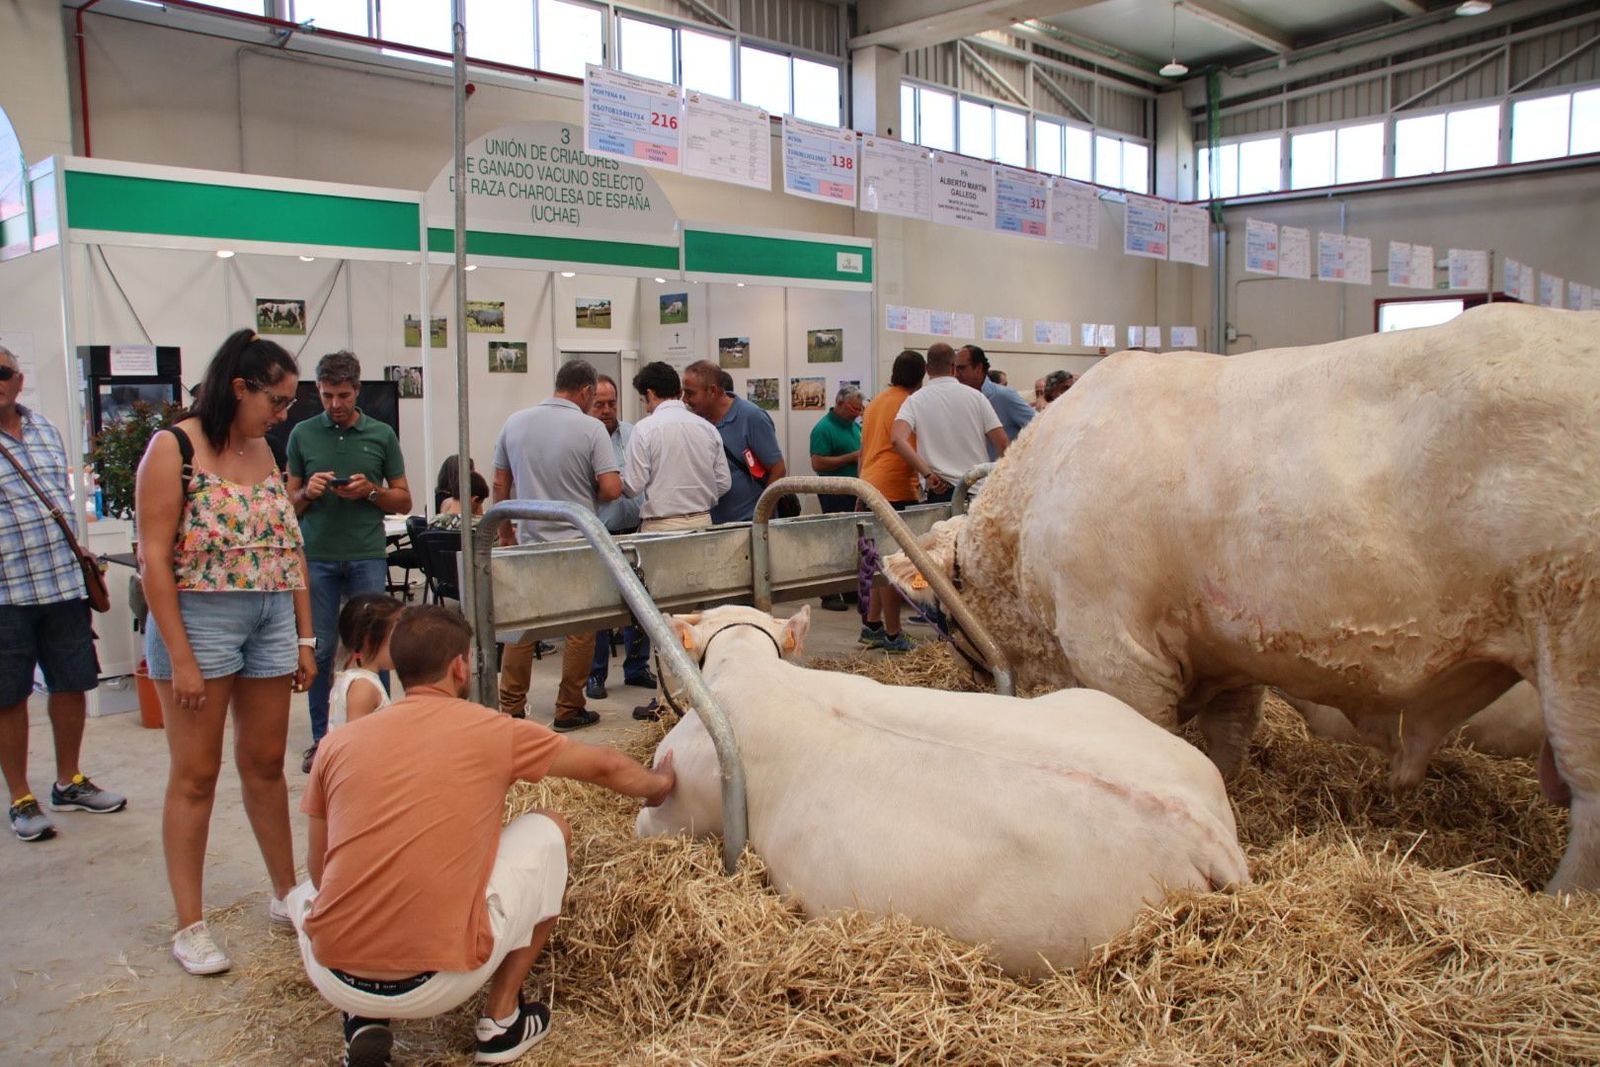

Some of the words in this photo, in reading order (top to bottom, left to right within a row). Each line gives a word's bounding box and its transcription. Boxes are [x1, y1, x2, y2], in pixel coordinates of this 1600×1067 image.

[651, 112, 678, 130] 216
[560, 127, 571, 145] 3
[485, 138, 527, 159] UNIÓN
[530, 144, 548, 162] DE
[832, 154, 854, 170] 138
[478, 158, 534, 180] GANADO
[536, 165, 589, 186] VACUNO
[592, 171, 644, 192] SELECTO
[940, 177, 967, 189] ALBERTO
[471, 178, 506, 197] RAZA
[508, 181, 585, 205] CHAROLESA
[587, 190, 603, 207] DE
[605, 192, 651, 211] ESPAÑA
[950, 188, 977, 200] GALLEGO
[1030, 198, 1046, 210] 317
[531, 203, 580, 227] (UCHAE)
